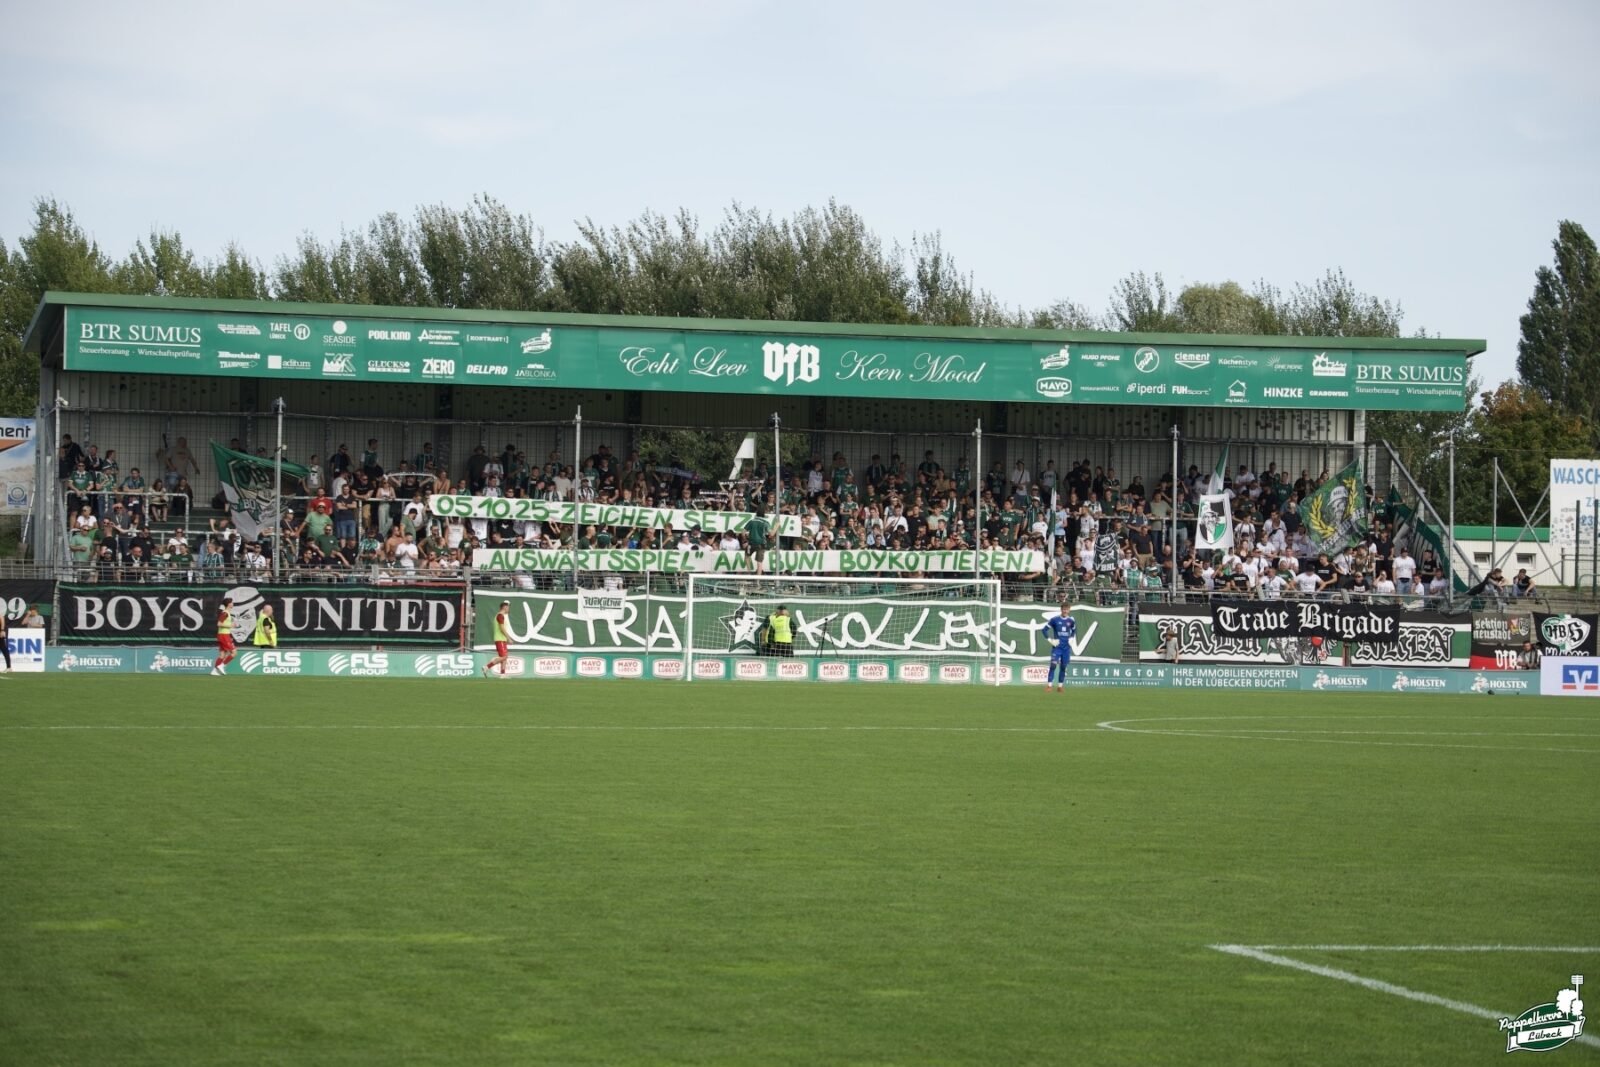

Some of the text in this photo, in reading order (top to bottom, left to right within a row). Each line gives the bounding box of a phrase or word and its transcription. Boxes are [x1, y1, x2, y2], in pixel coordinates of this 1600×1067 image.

[81, 323, 122, 340] BTR
[128, 325, 201, 343] SUMUS
[269, 322, 292, 333] TAFEL
[323, 335, 356, 344] SEASIDE
[80, 346, 200, 359] Steuerberatung Wirtschaftsprüfung
[1174, 352, 1210, 361] clement
[619, 346, 749, 377] Echt Leev
[835, 350, 986, 383] Keen Mood
[466, 364, 508, 375] DELLPRO
[515, 369, 557, 378] JABLONKA
[1357, 364, 1463, 382] BTR SUMUS
[1040, 382, 1069, 390] MAYO
[1137, 383, 1166, 395] iperdi
[1264, 388, 1303, 397] HINZKE
[683, 511, 795, 536] SETZN:
[839, 551, 1033, 572] BOYKOTTIEREN!
[73, 596, 456, 633] BOYS UNITED
[1217, 603, 1394, 639] Trave Brigade
[79, 657, 121, 666] HOLSTEN
[171, 659, 212, 668] HOLSTEN
[263, 653, 302, 667] FLS
[351, 653, 389, 667] FLS
[436, 654, 474, 669] FLS
[437, 669, 474, 677] GROUP
[1065, 668, 1165, 678] ENSINGTON
[1172, 668, 1298, 679] IHRE IMMOBILIENEXPERTEN
[1172, 677, 1288, 688] IN DER LÜBECKER BUCHT.
[1331, 677, 1368, 686] HOLSTEN
[1410, 679, 1446, 688] HOLSTEN
[1489, 680, 1528, 689] HOLSTEN
